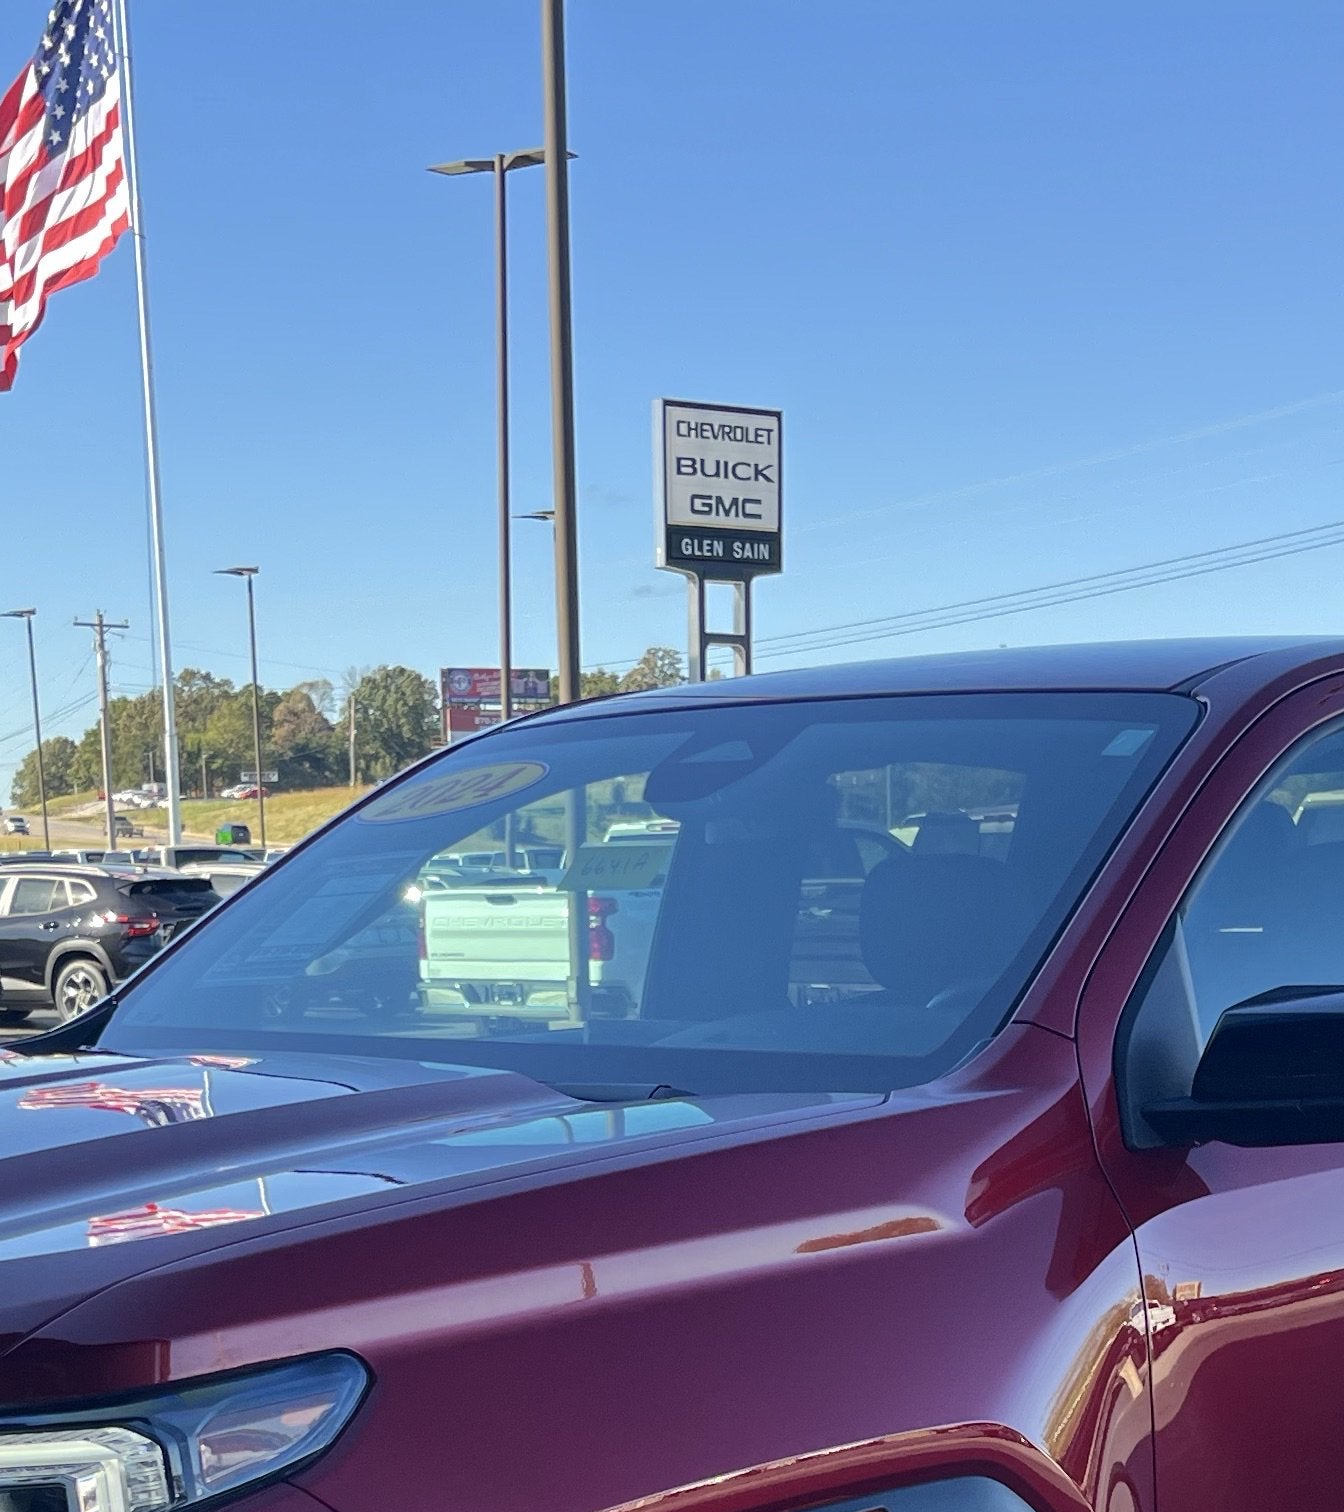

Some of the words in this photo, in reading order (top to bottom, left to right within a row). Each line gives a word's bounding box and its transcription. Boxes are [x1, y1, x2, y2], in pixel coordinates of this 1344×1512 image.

[676, 420, 774, 446] CHEVROLET
[676, 456, 775, 484] BUICK
[690, 494, 762, 520] GMC
[681, 538, 724, 557] GLEN
[732, 541, 770, 560] SAIN
